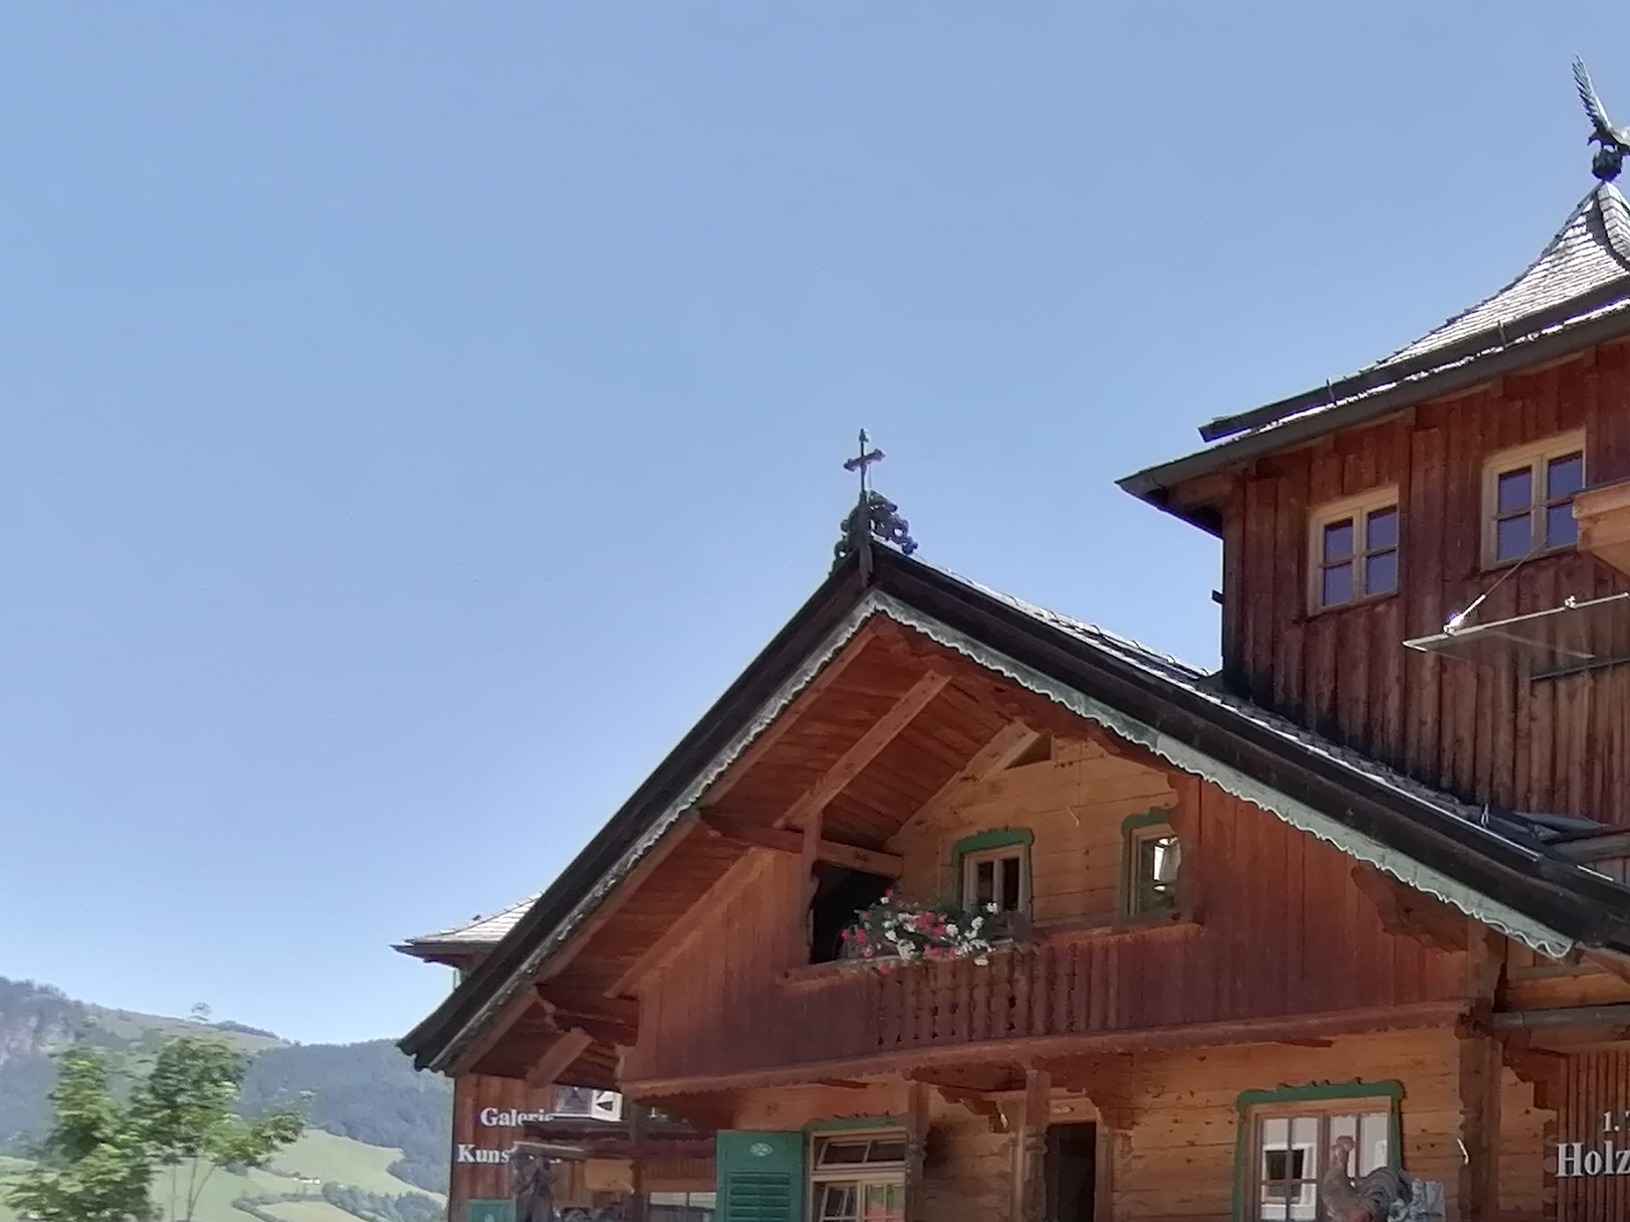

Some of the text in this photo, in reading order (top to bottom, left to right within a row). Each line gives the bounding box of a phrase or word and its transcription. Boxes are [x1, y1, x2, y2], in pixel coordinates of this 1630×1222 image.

[480, 1107, 553, 1127] Galerie
[1602, 1111, 1620, 1132] 1.
[457, 1144, 511, 1164] Kuns
